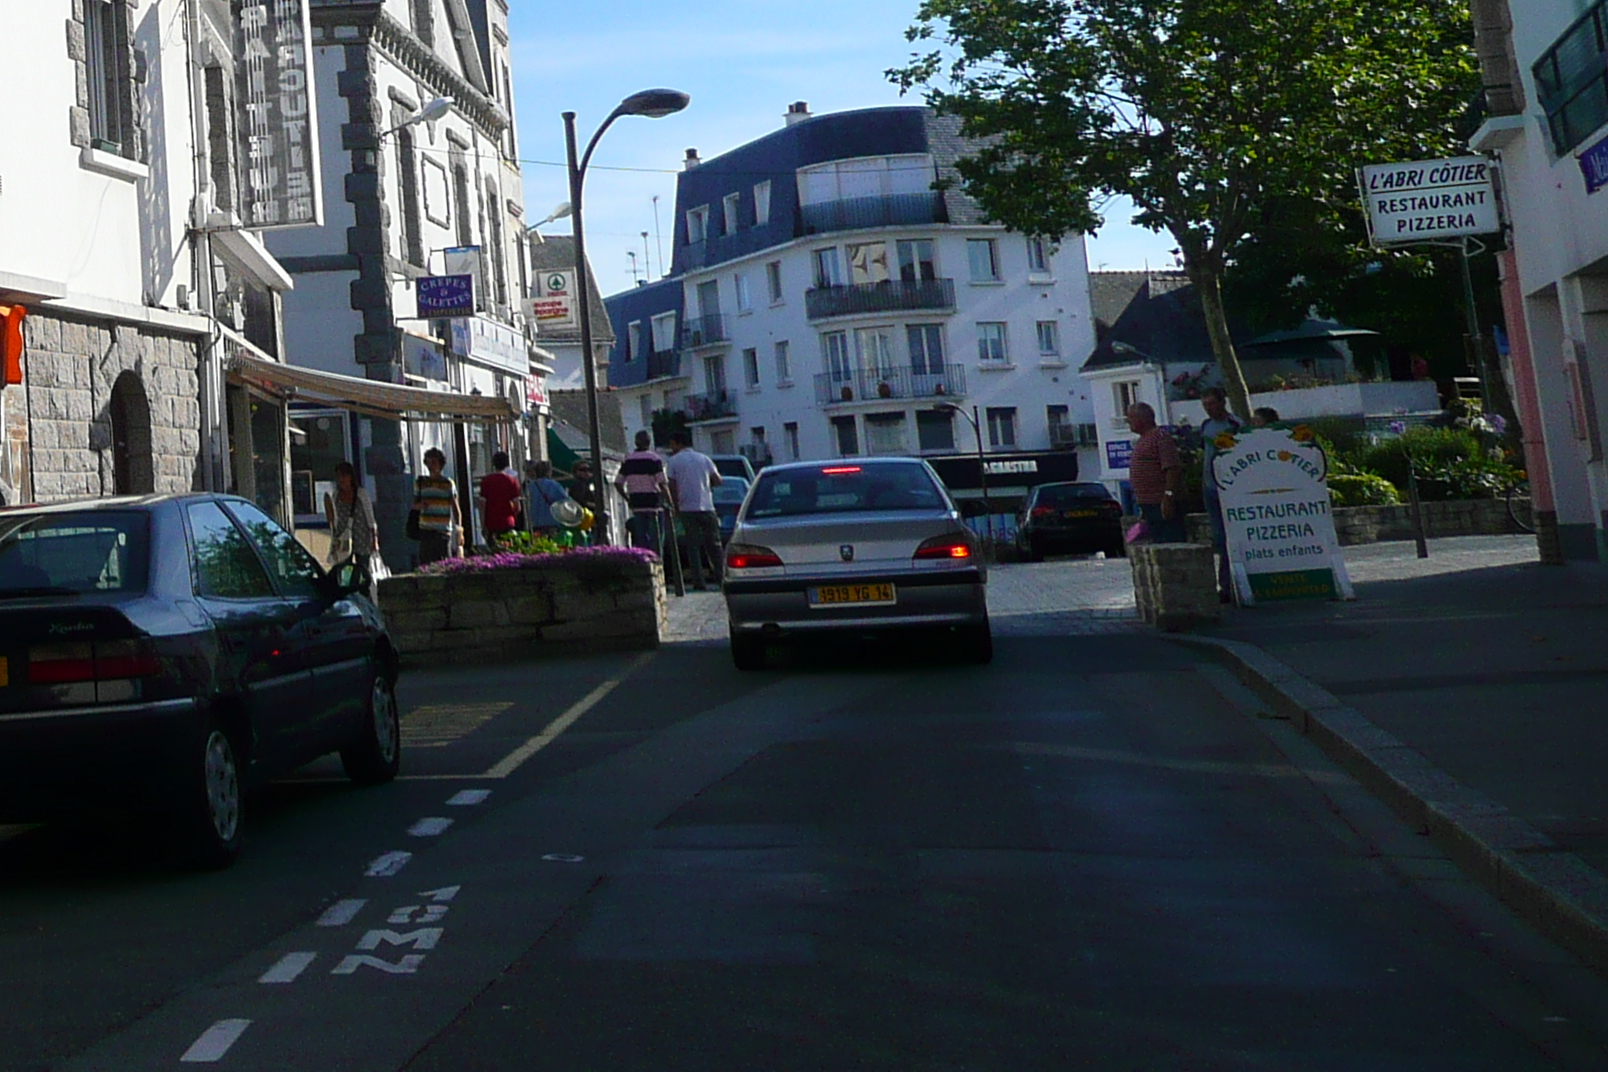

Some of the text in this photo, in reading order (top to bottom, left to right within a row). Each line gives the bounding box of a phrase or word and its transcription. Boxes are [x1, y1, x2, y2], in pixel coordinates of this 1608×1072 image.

[1370, 162, 1487, 190] L'ABRI CÔTIER
[1378, 191, 1486, 214] RESTAURANT
[1397, 213, 1476, 233] PIZZERIA
[418, 290, 471, 308] GALETTES
[1221, 451, 1262, 485] L'ABRI
[1227, 501, 1327, 522] RESTAURANT
[1247, 523, 1314, 541] PIZZERIA
[1245, 544, 1323, 561] plats enfants
[854, 586, 870, 601] YG
[876, 584, 890, 600] 14
